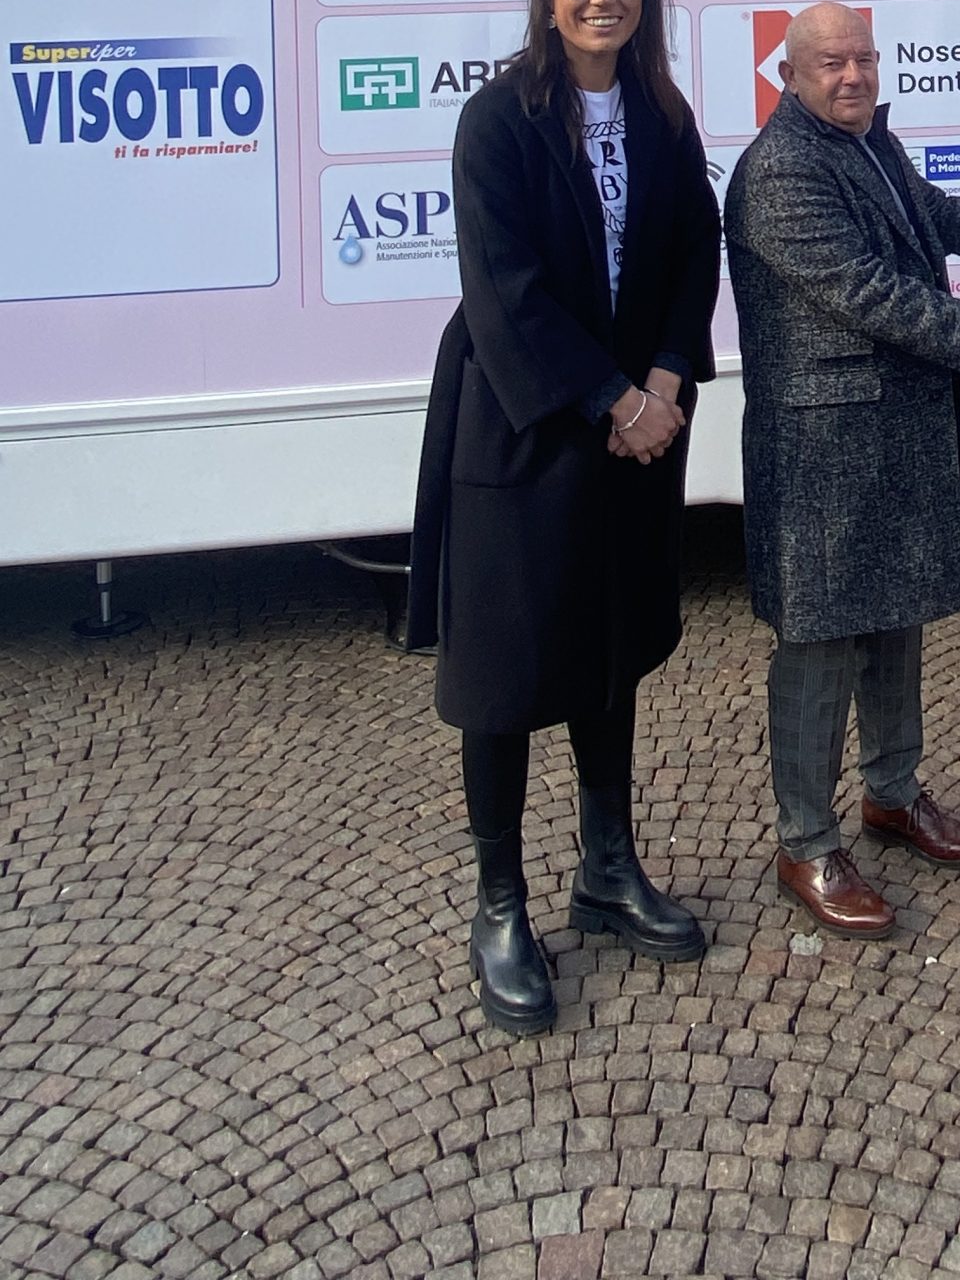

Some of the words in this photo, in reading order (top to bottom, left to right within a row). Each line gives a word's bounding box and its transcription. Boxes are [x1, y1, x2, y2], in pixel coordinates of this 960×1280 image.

[22, 43, 137, 64] Superiper
[12, 63, 265, 145] VISOTTO
[114, 145, 127, 159] ti
[133, 144, 150, 158] fa
[155, 140, 259, 159] risparmiare!
[333, 190, 457, 241] ASP
[376, 240, 428, 251] Associazione
[430, 239, 458, 248] Nazion
[376, 250, 432, 261] Manutenzioni
